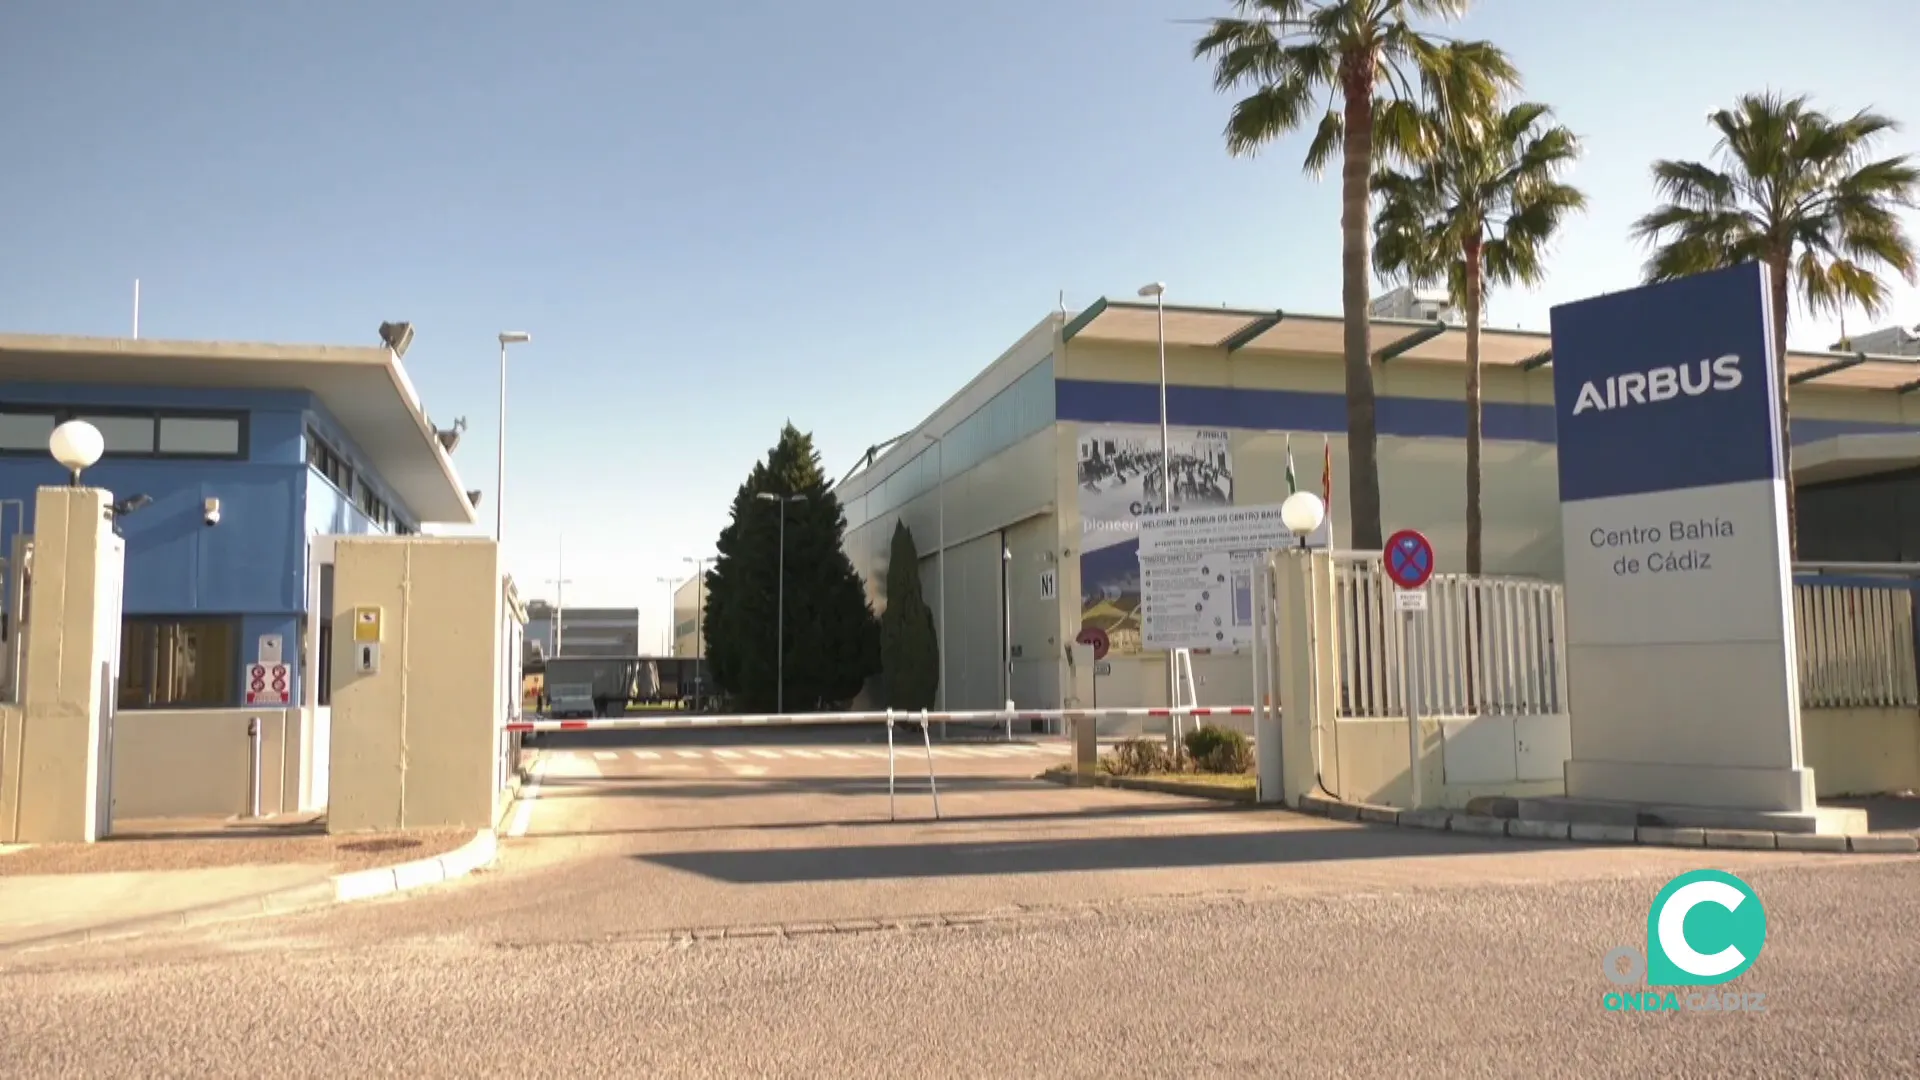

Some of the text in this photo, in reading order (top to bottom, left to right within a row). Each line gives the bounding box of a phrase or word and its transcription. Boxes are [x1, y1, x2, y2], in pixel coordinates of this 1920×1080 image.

[1572, 354, 1743, 416] AIRBUS
[1590, 516, 1734, 548] Centro Bahía
[1613, 549, 1712, 576] de Cádiz
[1041, 574, 1053, 596] N1
